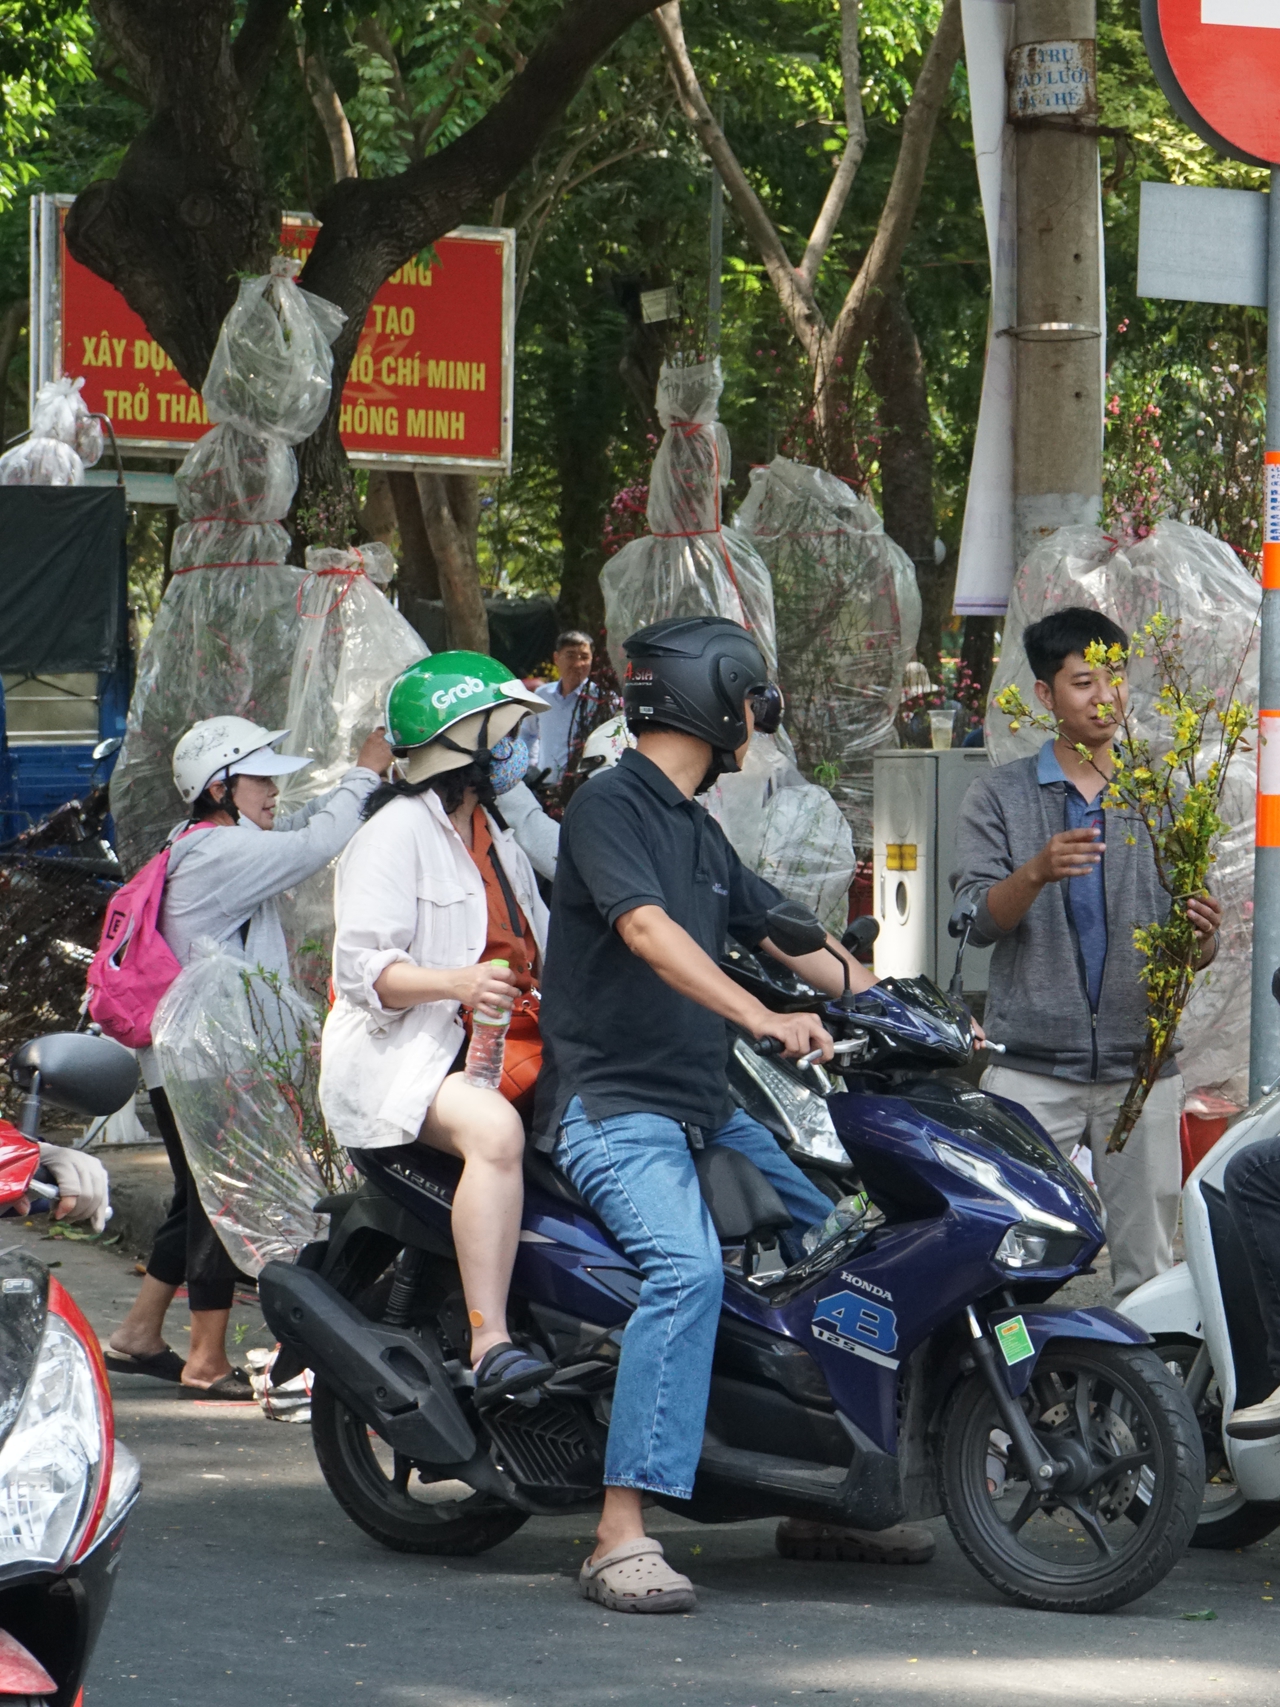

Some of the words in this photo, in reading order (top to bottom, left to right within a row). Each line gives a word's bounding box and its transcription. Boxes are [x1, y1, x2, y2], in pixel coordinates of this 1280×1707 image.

[373, 305, 415, 342] TẠO
[82, 330, 127, 368] XÂY
[382, 351, 420, 388] CHÍ
[428, 359, 486, 392] MINH
[103, 382, 149, 422] TRỞ
[339, 398, 398, 436] HÔNG
[407, 408, 465, 440] MINH
[431, 676, 485, 709] Grab
[840, 1270, 894, 1302] HONDA
[817, 1329, 857, 1352] 125
